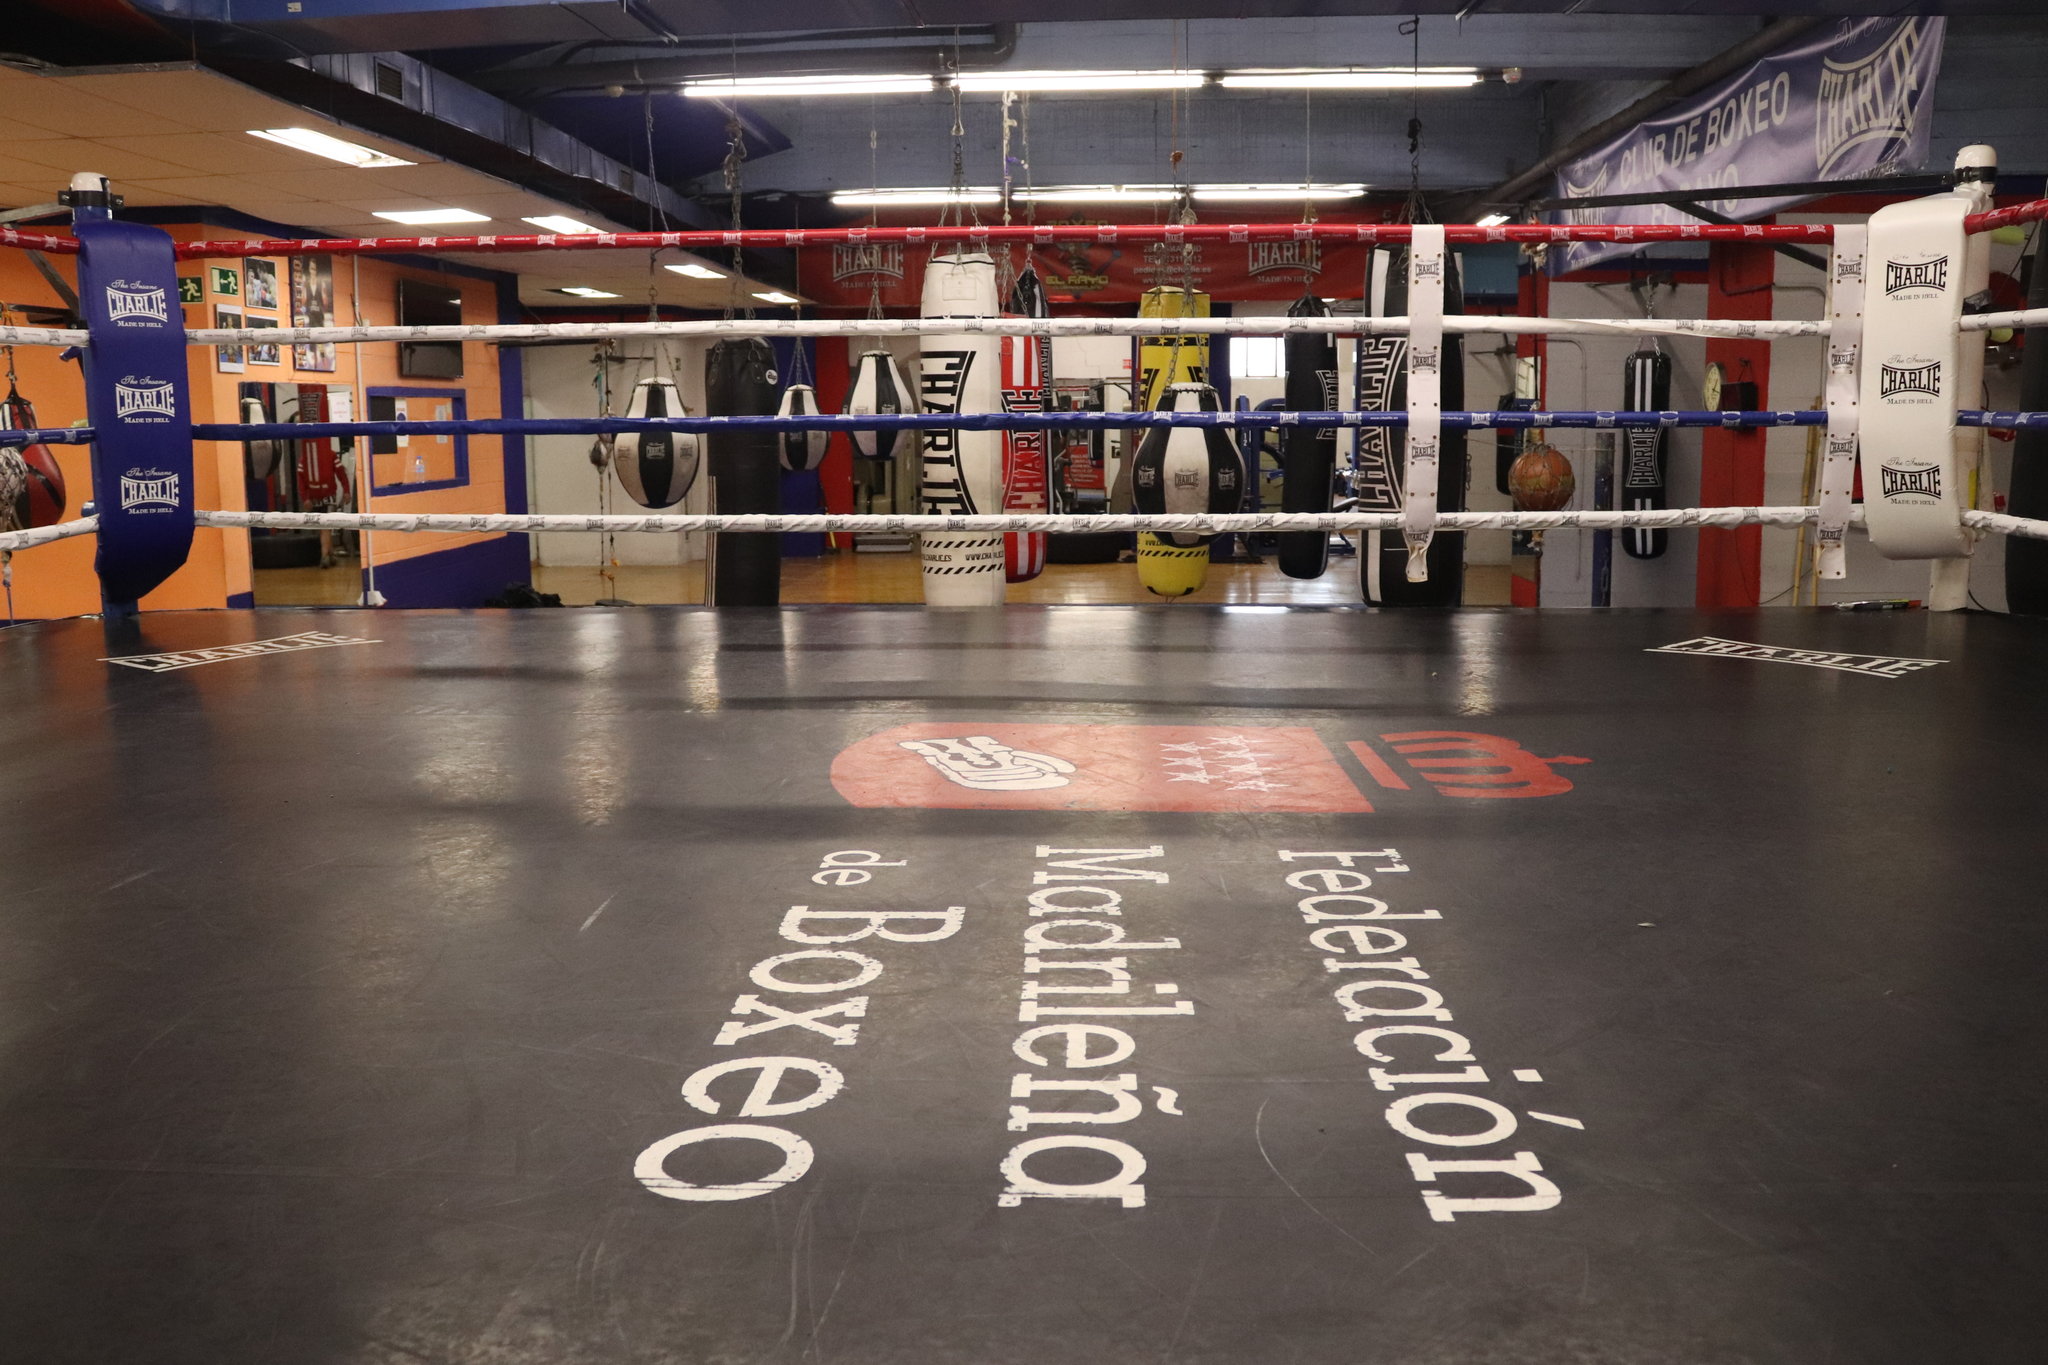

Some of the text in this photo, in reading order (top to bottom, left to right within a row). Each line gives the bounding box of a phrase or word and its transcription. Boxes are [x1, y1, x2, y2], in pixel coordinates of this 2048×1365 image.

[1815, 24, 1919, 169] CHARLIE
[1619, 71, 1790, 190] CLUB DE BOXEO
[833, 244, 904, 278] CHARLIE
[1415, 262, 1439, 276] CHARLIE
[1838, 262, 1861, 275] CHARLIE
[1886, 258, 1947, 293] CHARLIE
[107, 290, 167, 320] CHARLIE
[1413, 354, 1436, 368] CHARLIE
[1832, 353, 1855, 366] CHARLIE
[1881, 366, 1940, 396] CHARLIE
[116, 386, 175, 416] CHARLIE
[921, 351, 969, 514] CHARLIE
[1830, 441, 1853, 454] CHARLIE
[1006, 390, 1043, 510] CHARIE
[1412, 445, 1435, 459] CHARLIE
[121, 477, 179, 507] CHARLIE
[1882, 467, 1941, 497] CHARLIE
[1658, 638, 1939, 676] CHARLIE
[633, 849, 966, 1202] de Boxeo
[997, 844, 1195, 1208] Madrileña
[1277, 847, 1585, 1222] Federación
